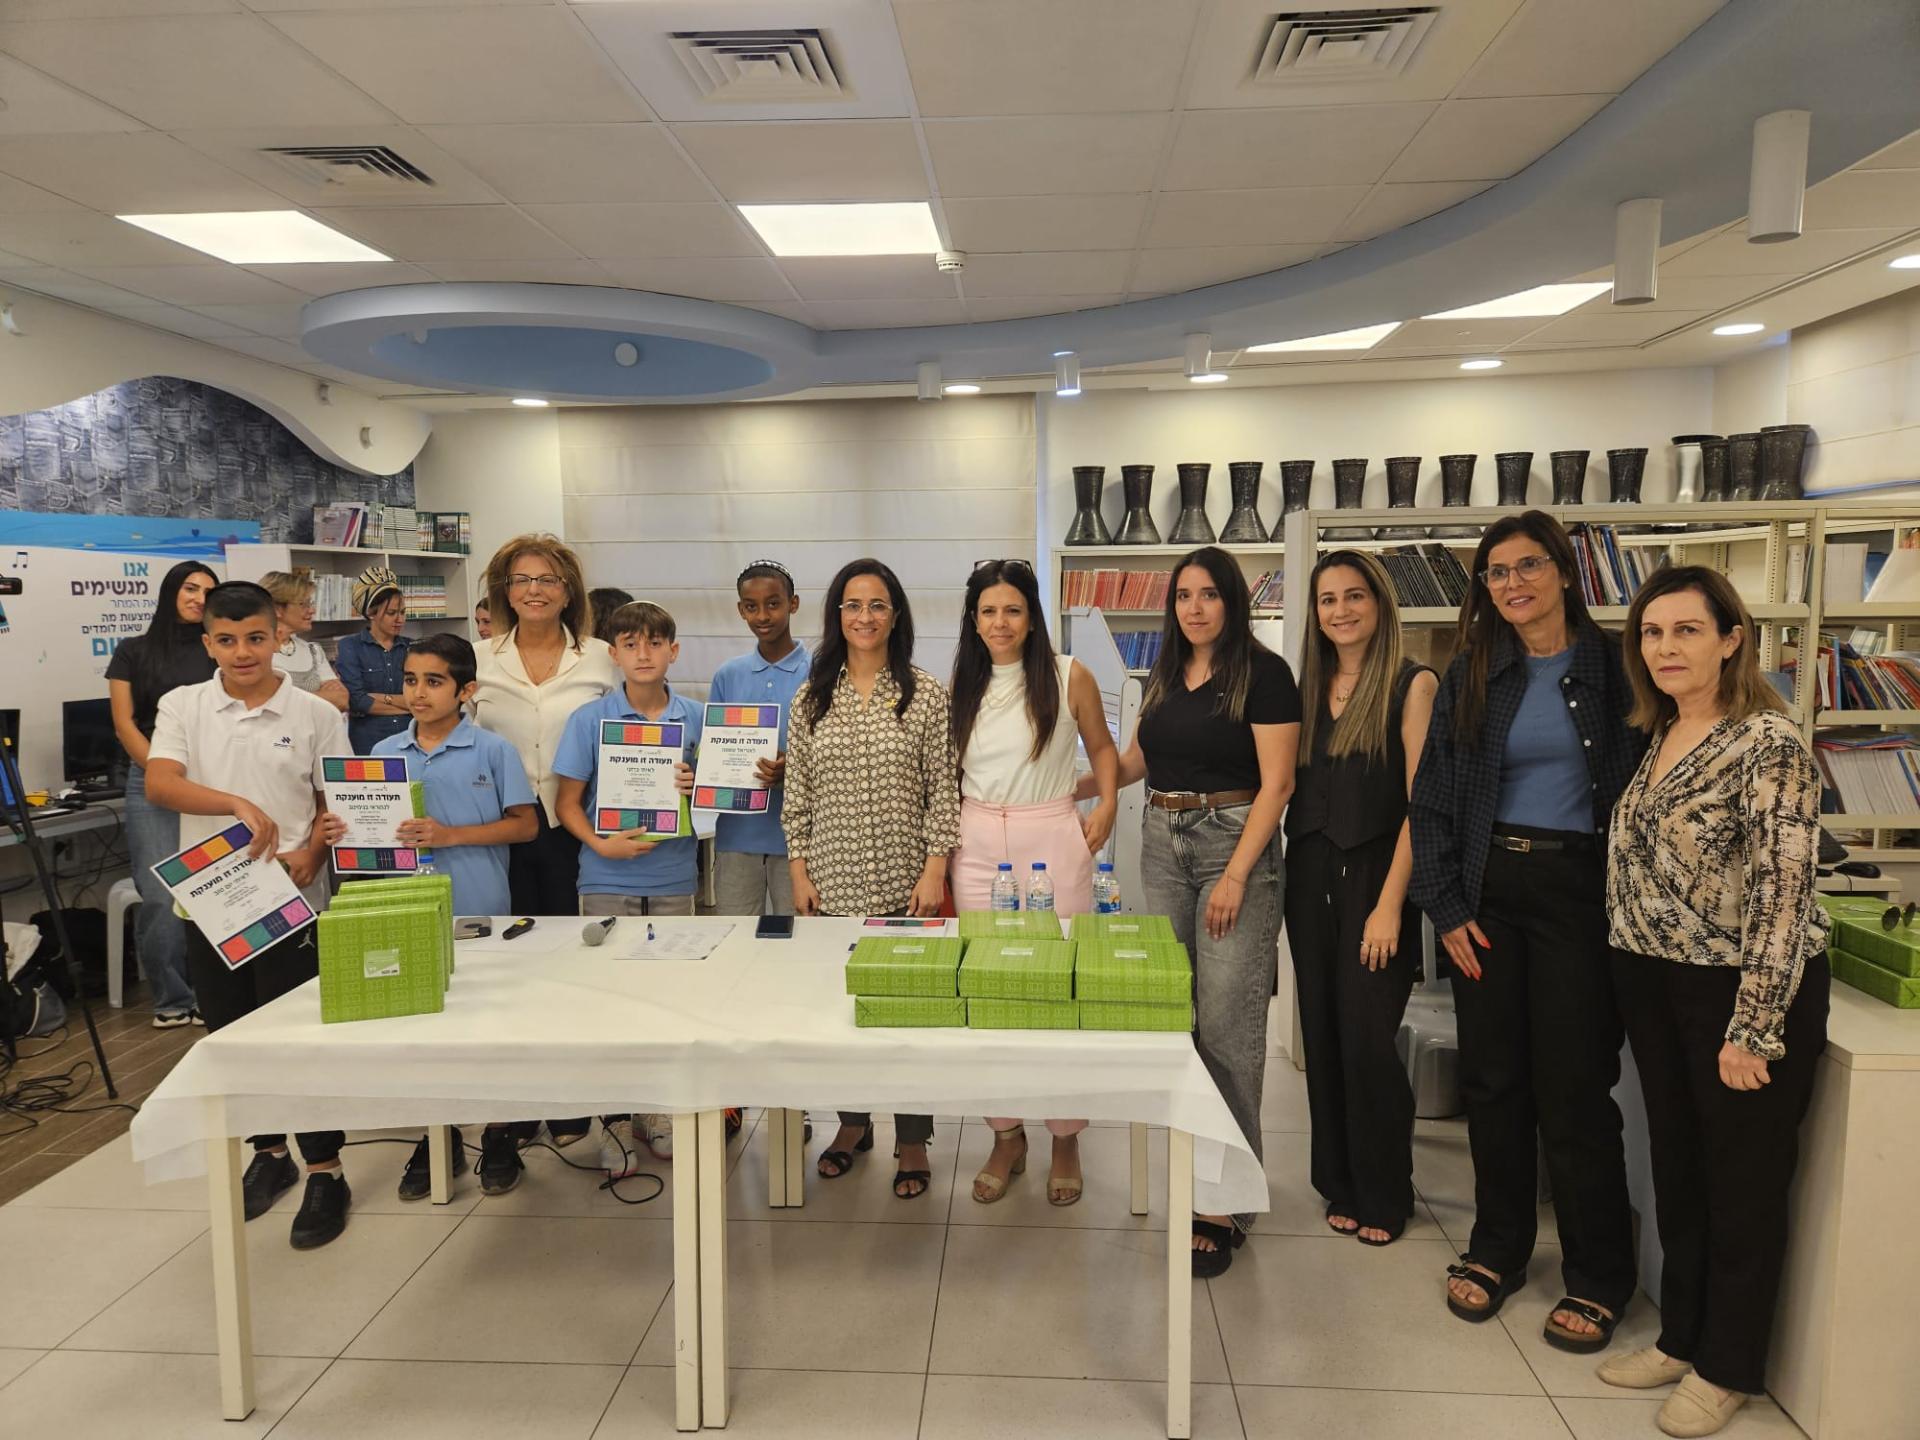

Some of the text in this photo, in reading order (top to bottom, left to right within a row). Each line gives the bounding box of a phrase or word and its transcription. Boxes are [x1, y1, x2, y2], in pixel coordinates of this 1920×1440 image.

[124, 562, 149, 576] אנו
[71, 581, 149, 596] מגשימים
[101, 611, 156, 623] מצעות מה
[81, 623, 143, 634] שאנו לומדים
[710, 736, 737, 745] מוענקת
[746, 737, 769, 745] תעודה
[609, 755, 639, 764] מוענקת
[649, 757, 673, 765] תעודה
[335, 793, 366, 802] מוענקת
[375, 793, 401, 801] תעודה
[231, 856, 260, 873] עודה
[222, 869, 233, 878] זו
[189, 875, 224, 898] מוענקת
